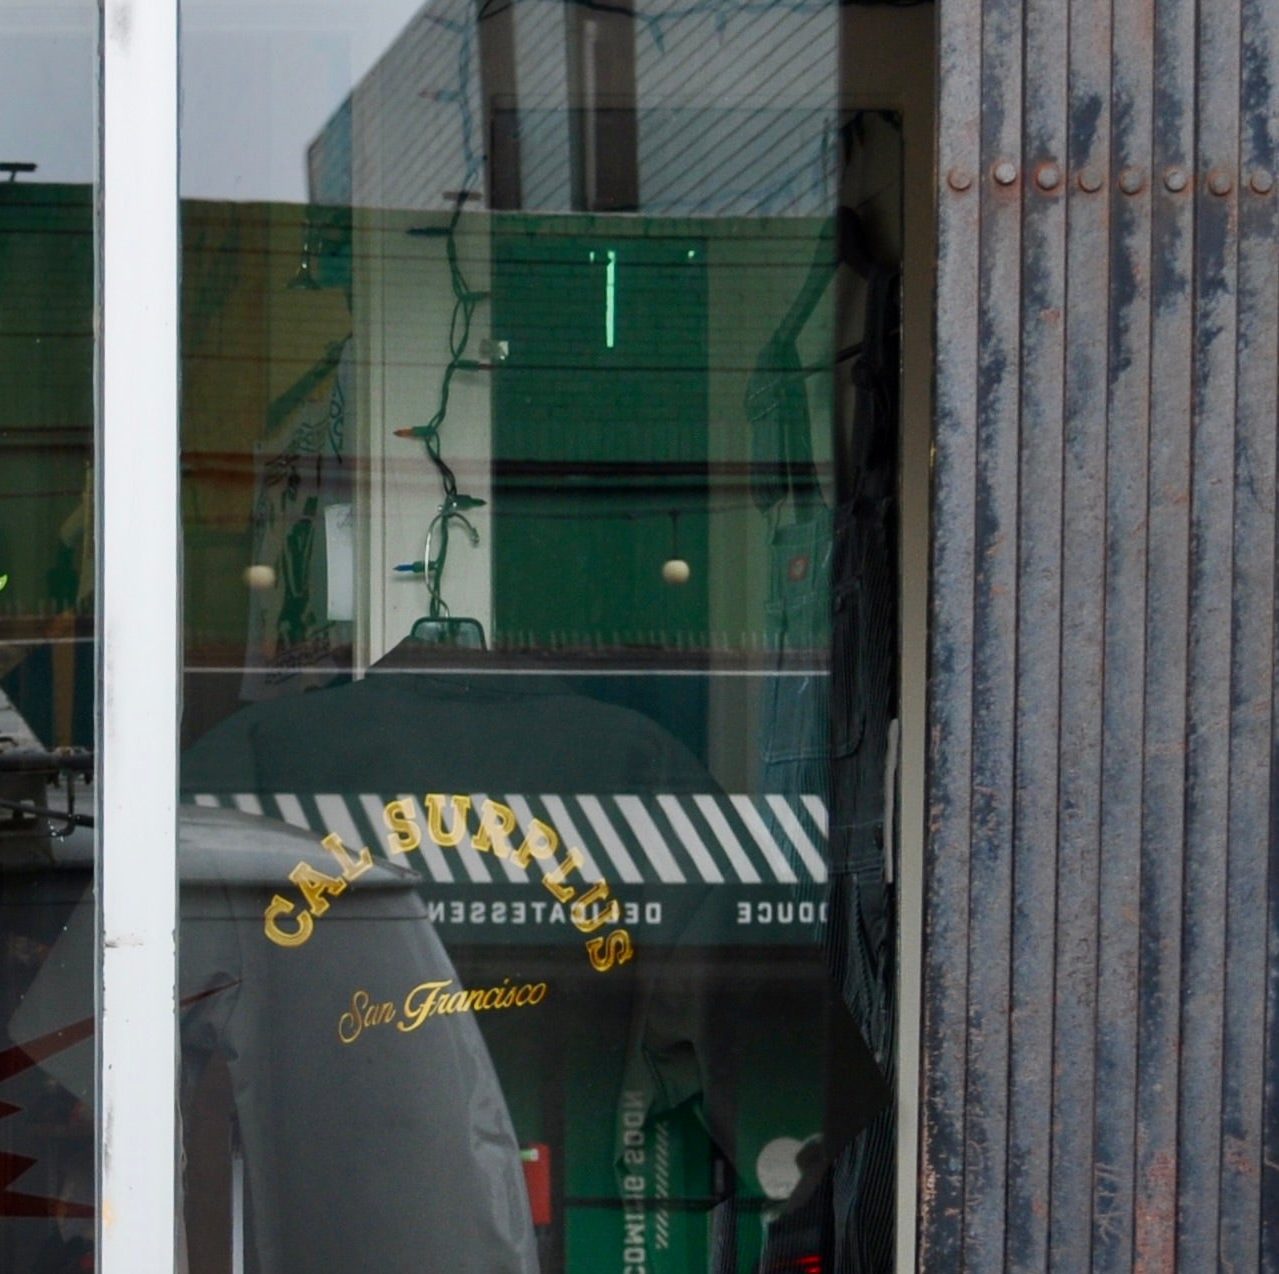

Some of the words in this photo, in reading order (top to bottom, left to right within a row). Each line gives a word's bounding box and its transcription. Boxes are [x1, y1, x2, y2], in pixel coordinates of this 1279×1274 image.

[264, 832, 373, 947] CAL
[382, 793, 633, 972] SURPLUS
[339, 990, 395, 1044] San
[396, 977, 547, 1033] Francisco
